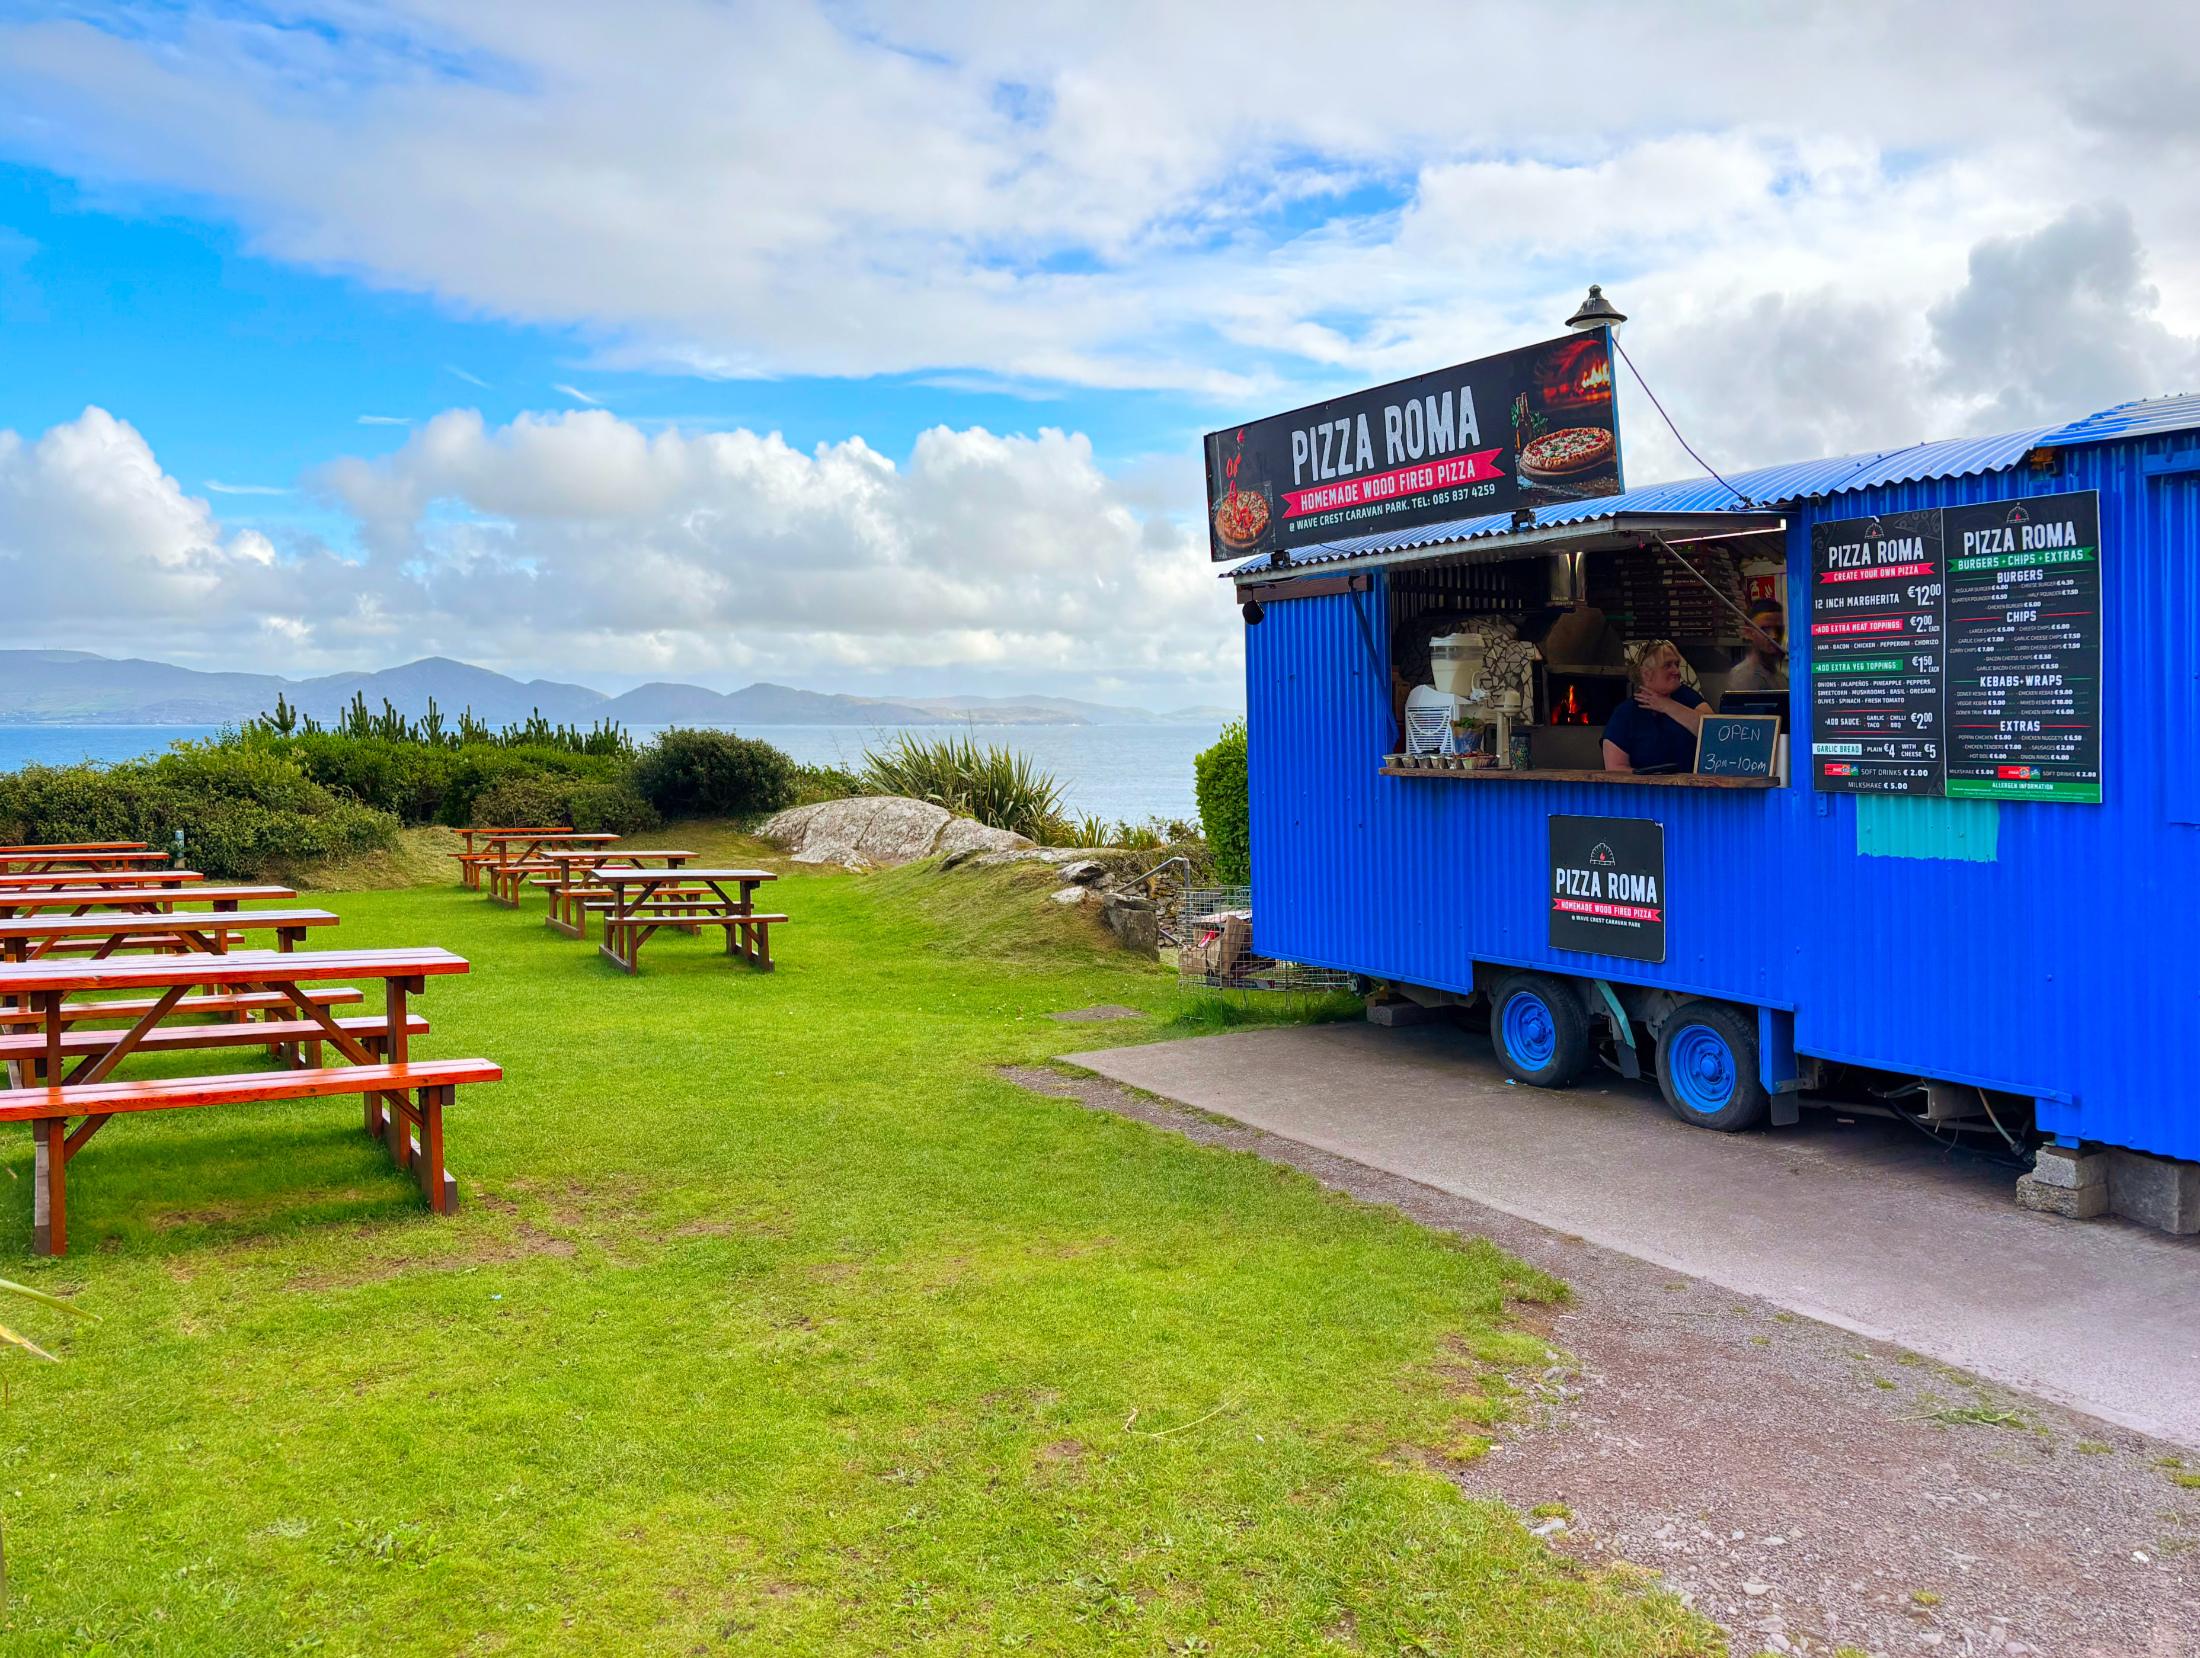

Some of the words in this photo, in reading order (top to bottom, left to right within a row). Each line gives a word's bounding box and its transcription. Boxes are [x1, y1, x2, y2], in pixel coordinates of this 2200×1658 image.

[1291, 412, 1375, 486] PIZZA
[1384, 385, 1481, 465] ROMA
[1300, 485, 1359, 512] HOMEMADE
[1362, 479, 1395, 499] WOOD
[1399, 470, 1433, 491] FIRED
[1437, 459, 1476, 483] PIZZA
[1289, 522, 1295, 532] @
[1296, 517, 1318, 530] WAVE
[1320, 512, 1344, 527] CREST
[1345, 506, 1383, 523] CARAVAN
[1385, 501, 1410, 514] PARK.
[1412, 497, 1431, 508] TEL:
[1432, 492, 1450, 505] 085
[1452, 488, 1469, 502] 837
[1471, 484, 1495, 498] 4259
[1963, 527, 2015, 556] PIZZA
[2021, 521, 2077, 550] ROMA
[1828, 542, 1872, 569] PIZZA
[1877, 536, 1924, 564] ROMA
[1958, 557, 1999, 570] BURGERS
[2008, 554, 2036, 566] CHIPS
[2045, 549, 2084, 563] EXTRAS
[1834, 572, 1858, 582] CREATE
[1860, 569, 1878, 579] YOUR
[1880, 567, 1896, 577] OWN
[1897, 565, 1919, 576] PIZZA
[1996, 569, 2044, 583] BURGERS
[1815, 599, 1823, 609] 12
[1825, 597, 1844, 609] INCH
[1847, 593, 1900, 607] MARGHERITA
[2006, 610, 2037, 623] CHIPS
[1831, 623, 1850, 633] EXTRA
[1852, 622, 1868, 631] MEAT
[1880, 640, 1910, 648] PEPPERONI
[1831, 662, 1850, 671] EXTRA
[1852, 662, 1864, 671] VEG
[1840, 679, 1869, 687] JALAPEÑOS
[1718, 724, 1760, 742] OPEN
[2000, 720, 2041, 732] EXTRAS
[1816, 745, 1838, 753] GARLIC
[1883, 743, 1896, 758] €4
[1924, 743, 1936, 759] €5
[1890, 782, 1908, 790] 5.00
[1556, 868, 1602, 898] PIZZA
[1608, 872, 1658, 904] ROMA
[1561, 900, 1592, 912] HOMEMADE
[1594, 904, 1612, 914] WOOD
[1614, 907, 1631, 917] FIRED
[1634, 909, 1652, 919] PIZZA
[1605, 919, 1628, 927] CARAVAN
